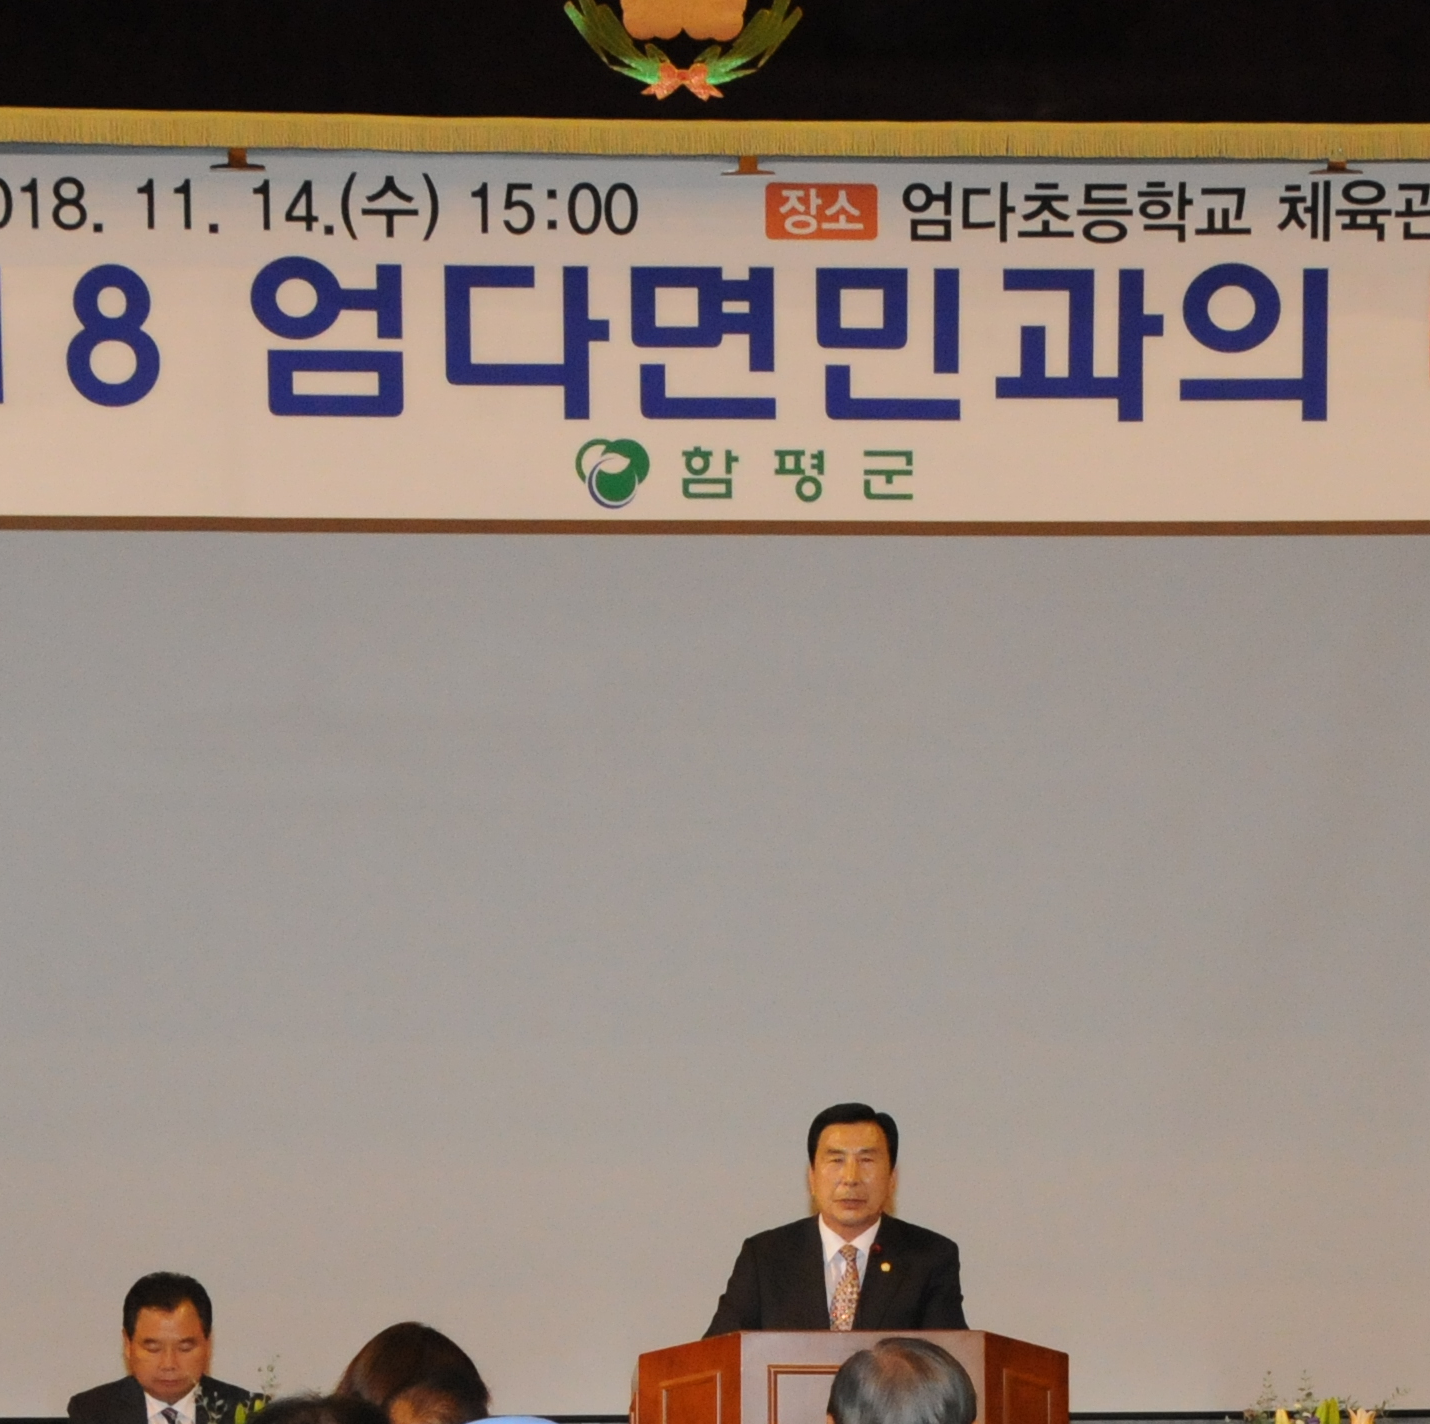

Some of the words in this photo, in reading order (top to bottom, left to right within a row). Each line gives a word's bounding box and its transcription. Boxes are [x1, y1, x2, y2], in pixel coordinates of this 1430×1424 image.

[135, 178, 219, 235] 11.
[251, 172, 440, 241] 14.(수)
[469, 181, 639, 237] 15:00
[778, 187, 865, 235] 장소
[901, 180, 1253, 244] 엄다초등학교
[251, 256, 1328, 421] 엄다면민과의
[681, 445, 914, 502] 함평군
